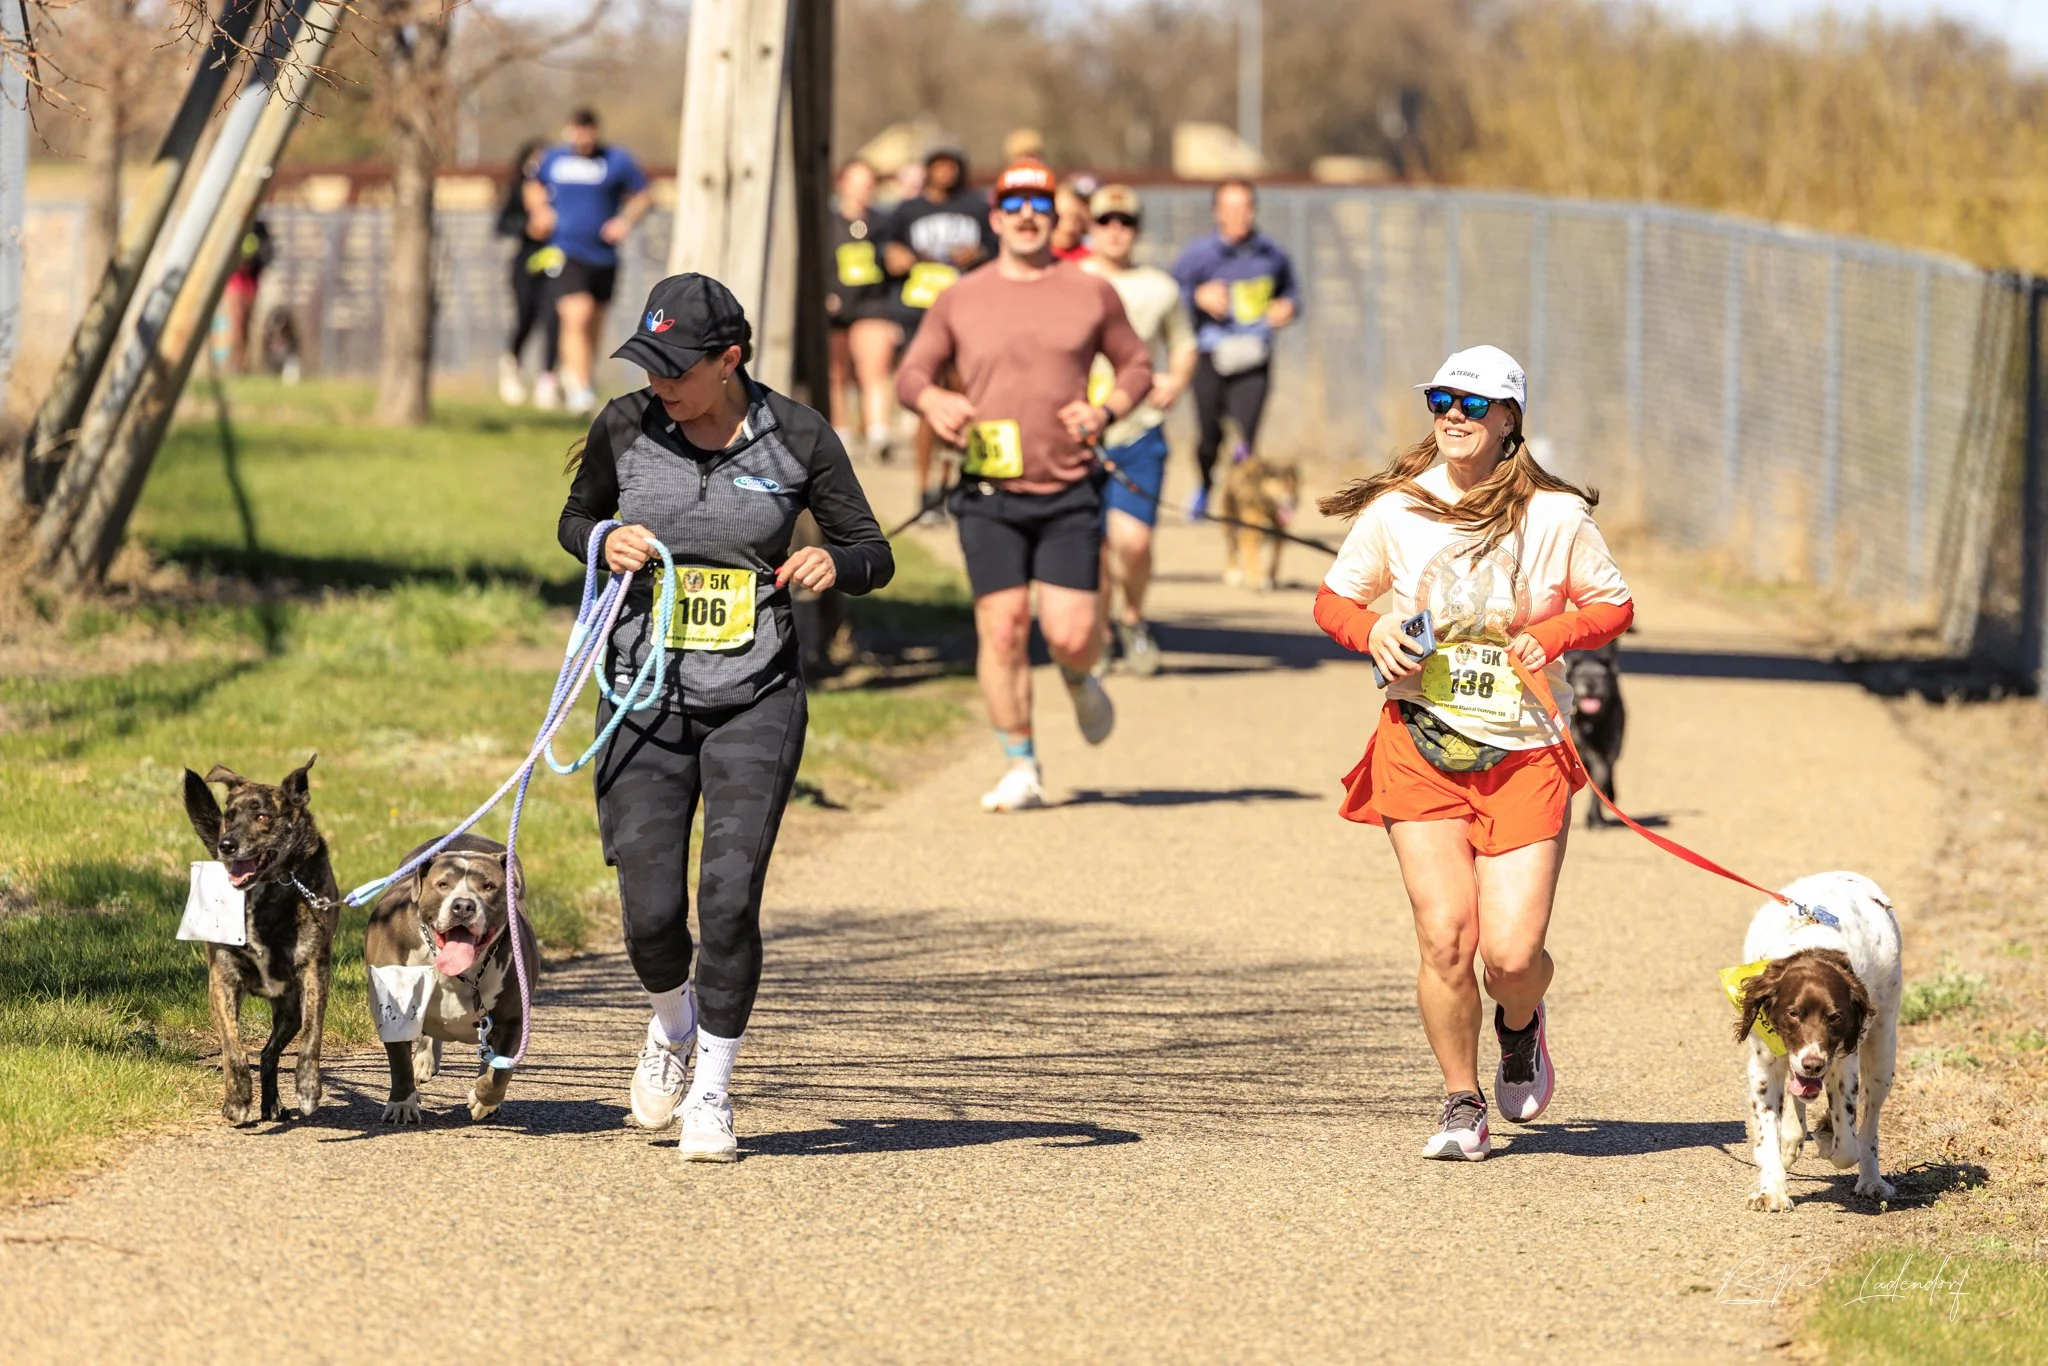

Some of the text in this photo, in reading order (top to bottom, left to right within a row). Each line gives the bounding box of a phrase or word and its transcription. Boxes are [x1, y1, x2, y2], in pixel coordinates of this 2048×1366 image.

[1457, 370, 1479, 379] TERREX
[710, 574, 730, 590] 5K
[679, 597, 726, 627] 106
[1482, 649, 1501, 666] 5K
[1450, 669, 1495, 698] 138
